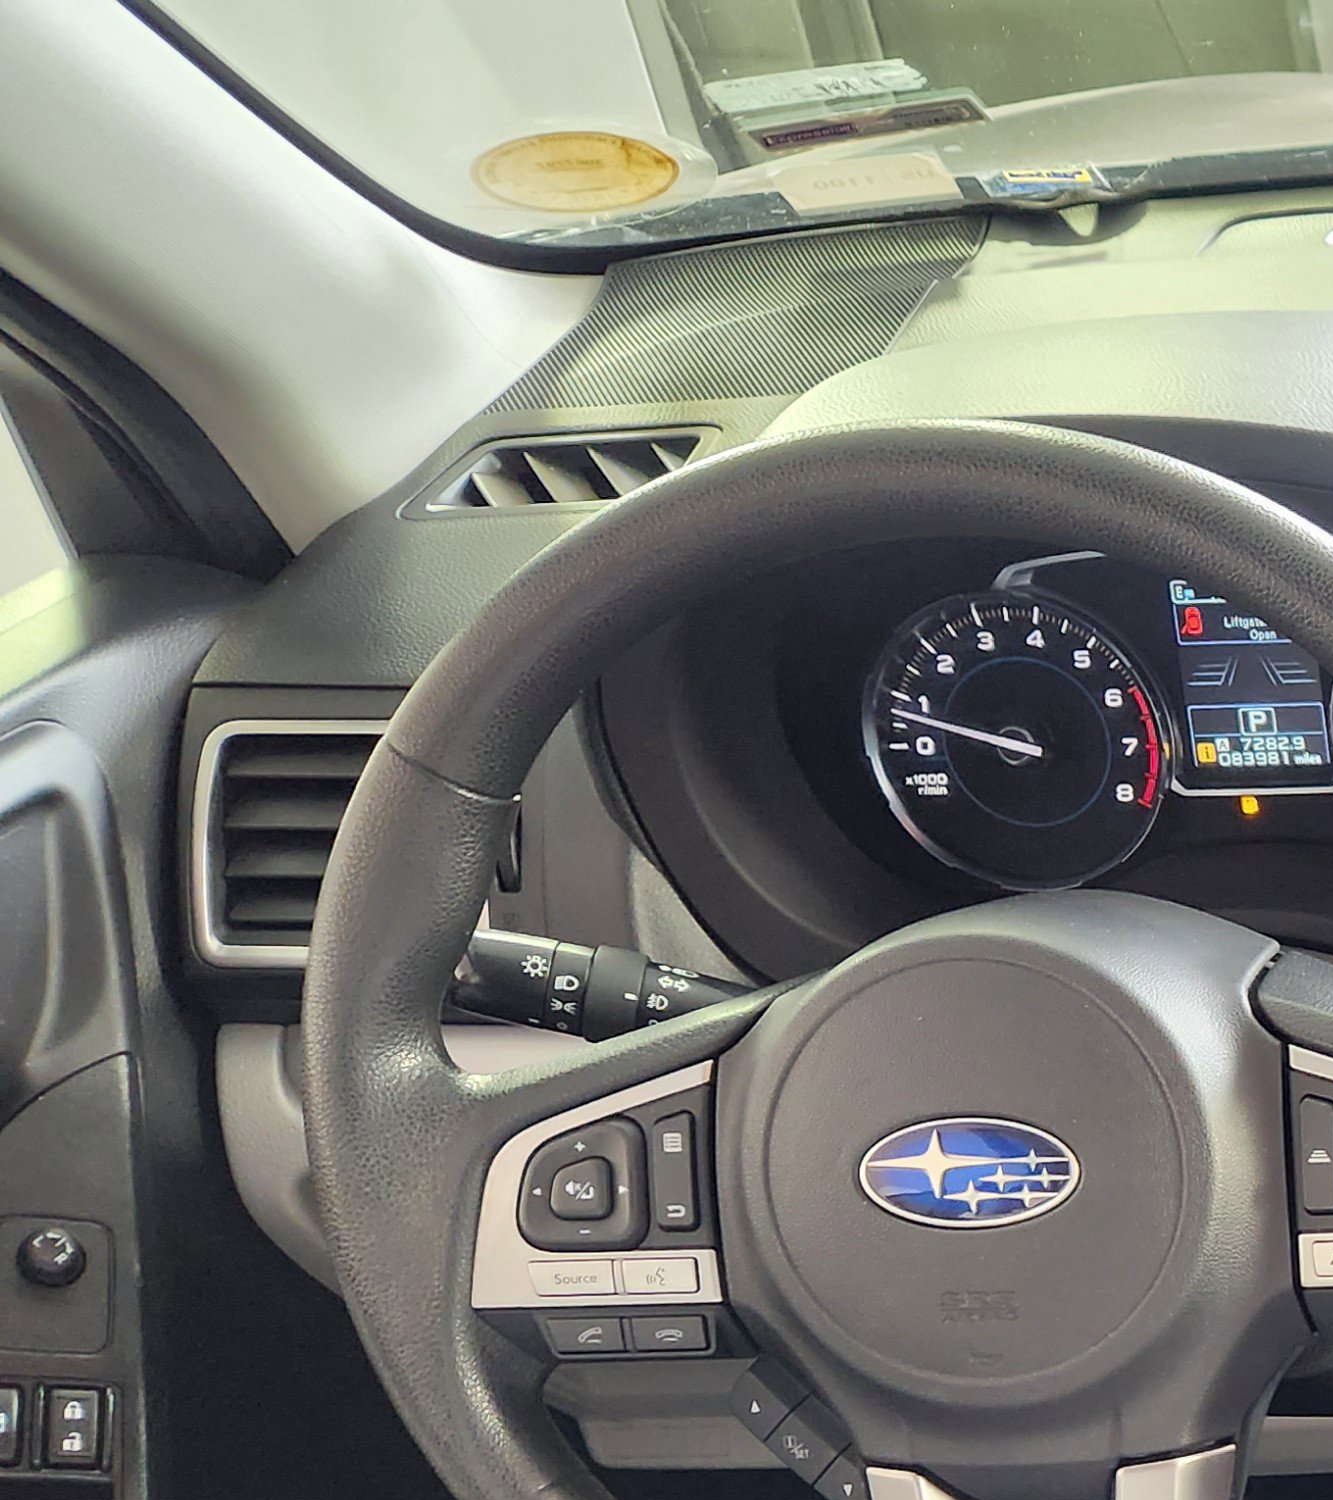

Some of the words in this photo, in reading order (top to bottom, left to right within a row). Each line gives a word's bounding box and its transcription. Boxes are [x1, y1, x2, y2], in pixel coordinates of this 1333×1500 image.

[977, 631, 995, 651] 3
[1026, 629, 1046, 649] 4
[1249, 629, 1277, 641] Open
[934, 654, 956, 674] 2
[1072, 649, 1092, 669] 5
[917, 695, 931, 713] 1
[1104, 687, 1124, 708] 6
[1247, 711, 1267, 732] P
[915, 736, 935, 756] 0
[1121, 737, 1139, 756] 7
[1240, 736, 1306, 751] 7282.9
[1218, 751, 1289, 767] 083981
[1292, 752, 1322, 765] miles
[917, 784, 949, 797] r/min
[1115, 782, 1135, 803] 8
[553, 1273, 598, 1285] Source
